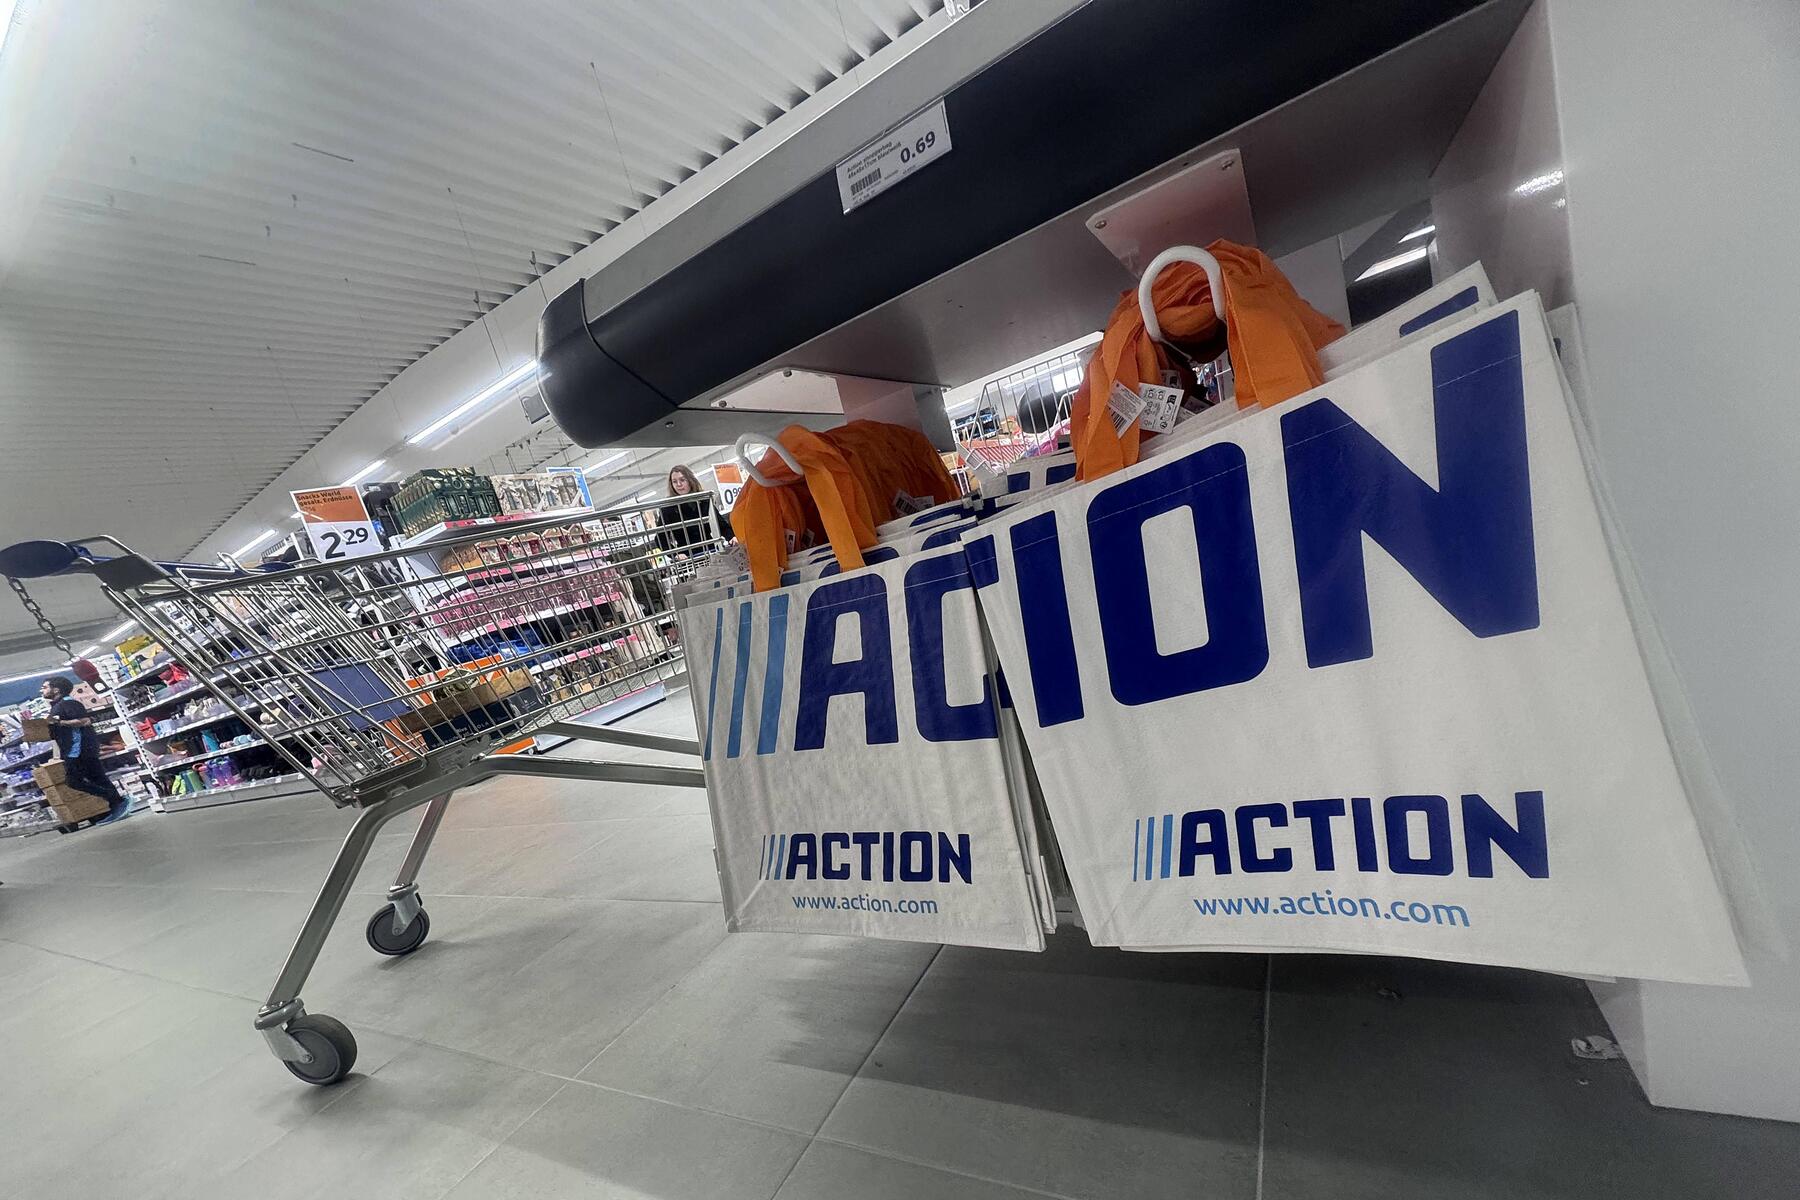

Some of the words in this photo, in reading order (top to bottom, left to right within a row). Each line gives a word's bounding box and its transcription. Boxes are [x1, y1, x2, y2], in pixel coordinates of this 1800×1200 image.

[900, 131, 936, 163] 0.69
[296, 493, 320, 501] Snacks
[962, 309, 1540, 728] ION
[1178, 790, 1550, 879] ACTION
[785, 831, 972, 884] ACTION
[792, 893, 939, 914] www.action.com
[1194, 889, 1471, 928] www.action.com
